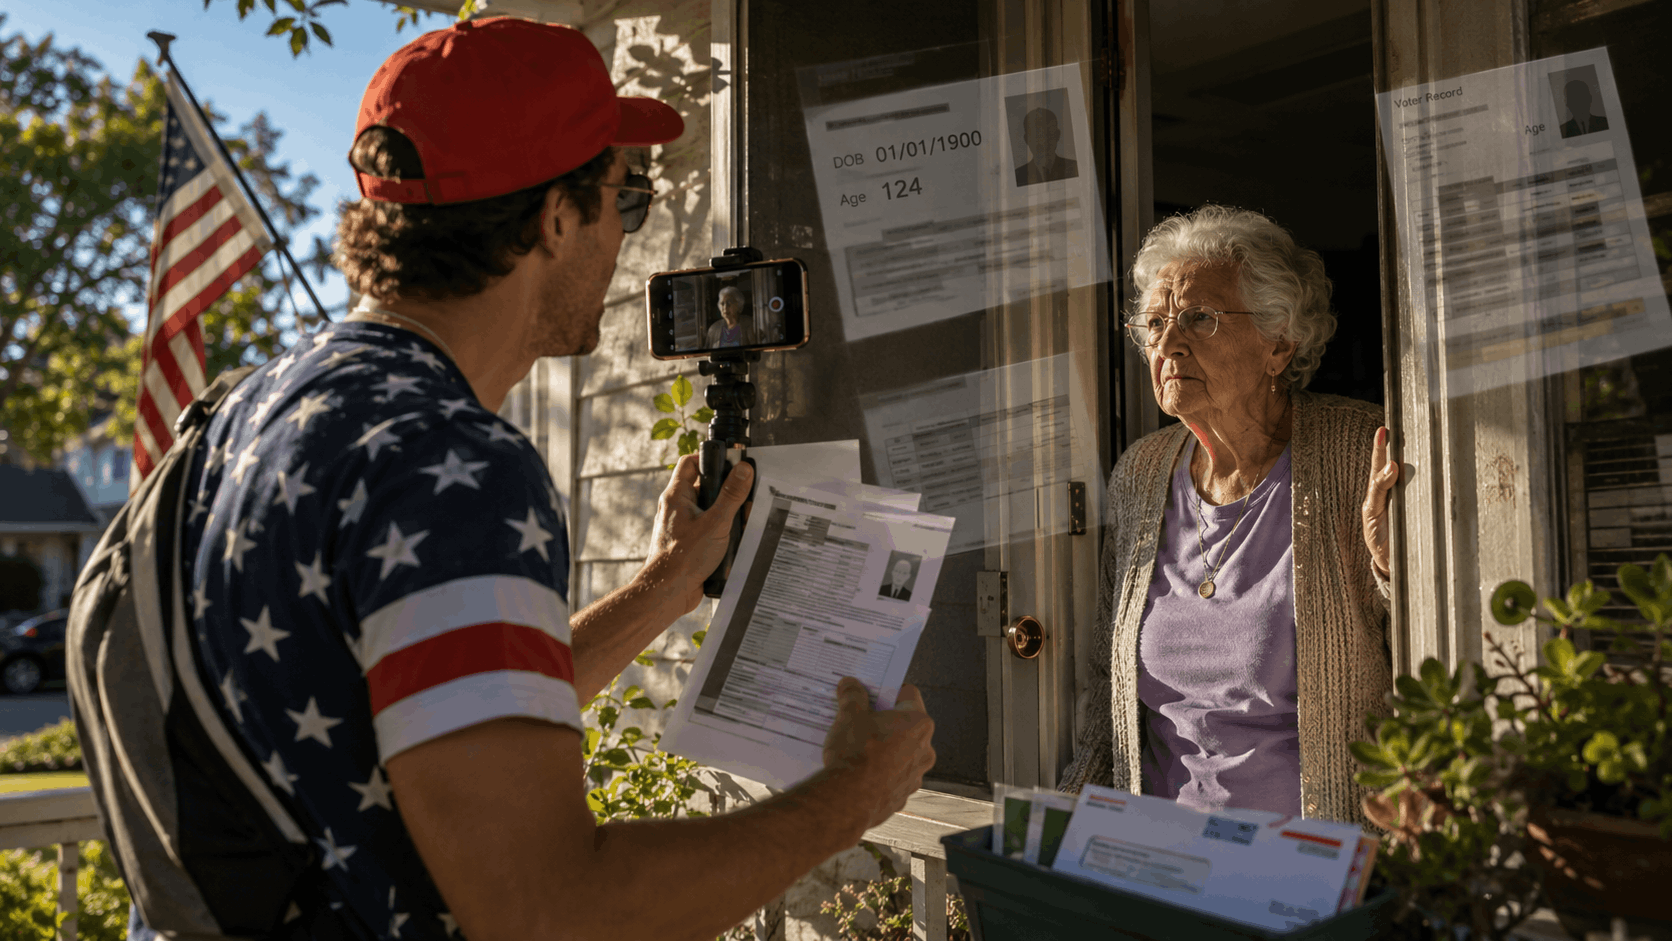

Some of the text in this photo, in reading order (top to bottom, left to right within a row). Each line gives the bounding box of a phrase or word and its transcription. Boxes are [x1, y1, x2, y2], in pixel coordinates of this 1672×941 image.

[1394, 87, 1463, 109] Voter Record
[1525, 123, 1546, 136] Age
[833, 130, 982, 169] DOB 01/01/1900
[840, 177, 923, 208] Age 124
